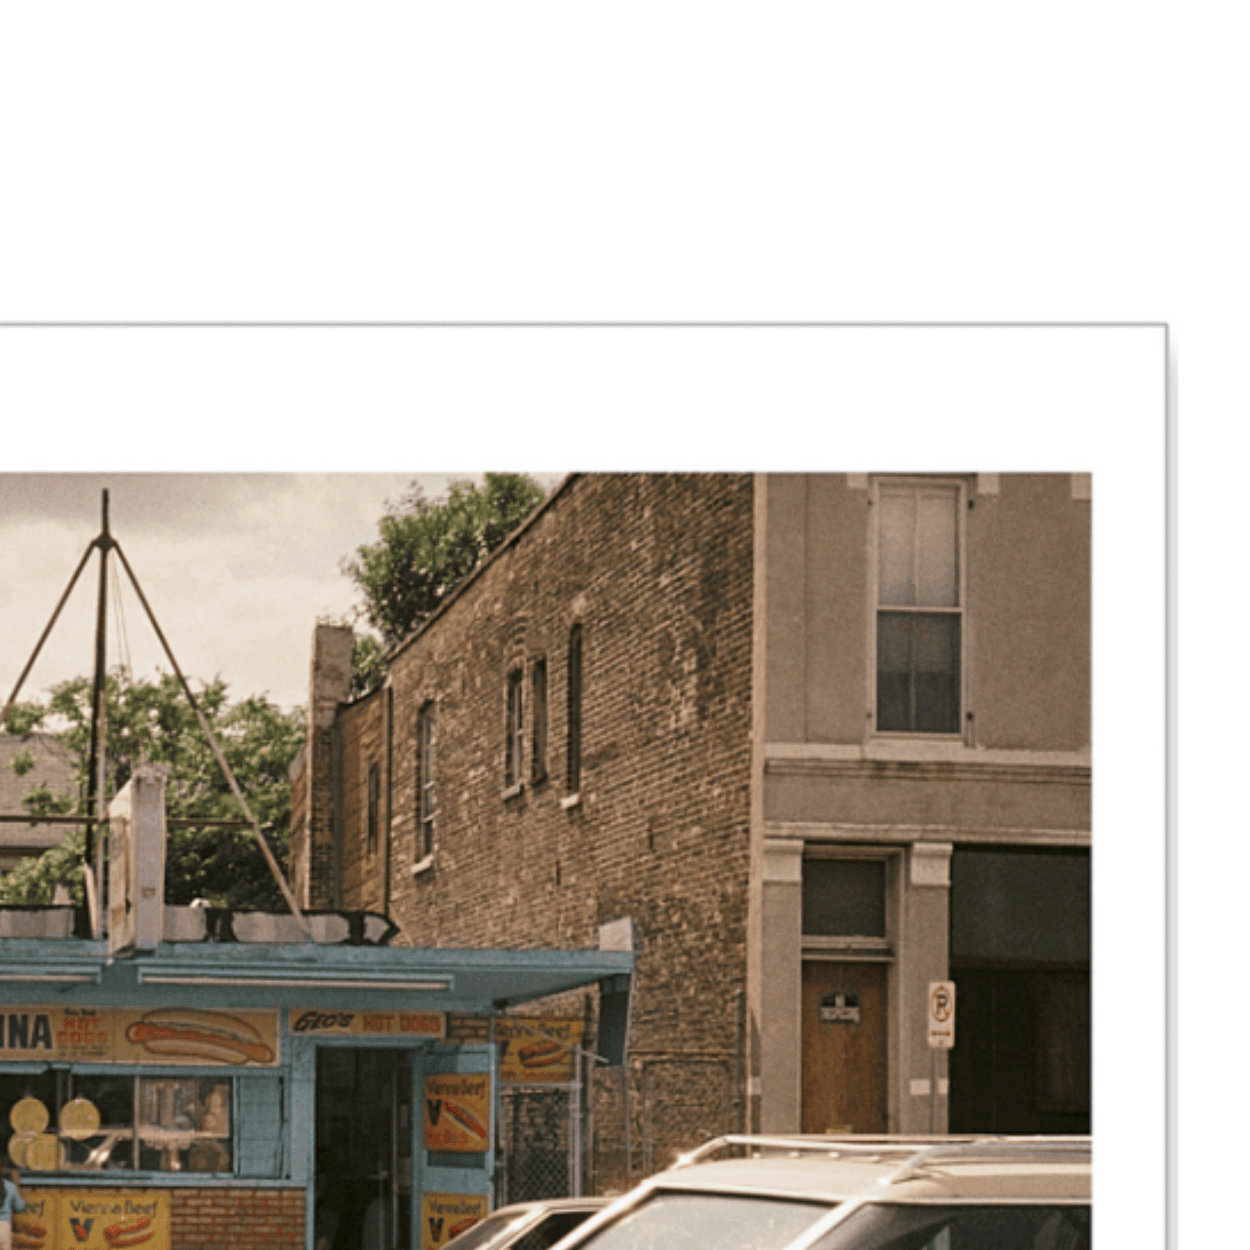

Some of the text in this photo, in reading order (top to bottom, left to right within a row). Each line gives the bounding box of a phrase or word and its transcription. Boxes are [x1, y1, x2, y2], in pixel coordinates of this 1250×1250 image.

[363, 1014, 395, 1033] HOT
[70, 1200, 158, 1218] Vienna Beef
